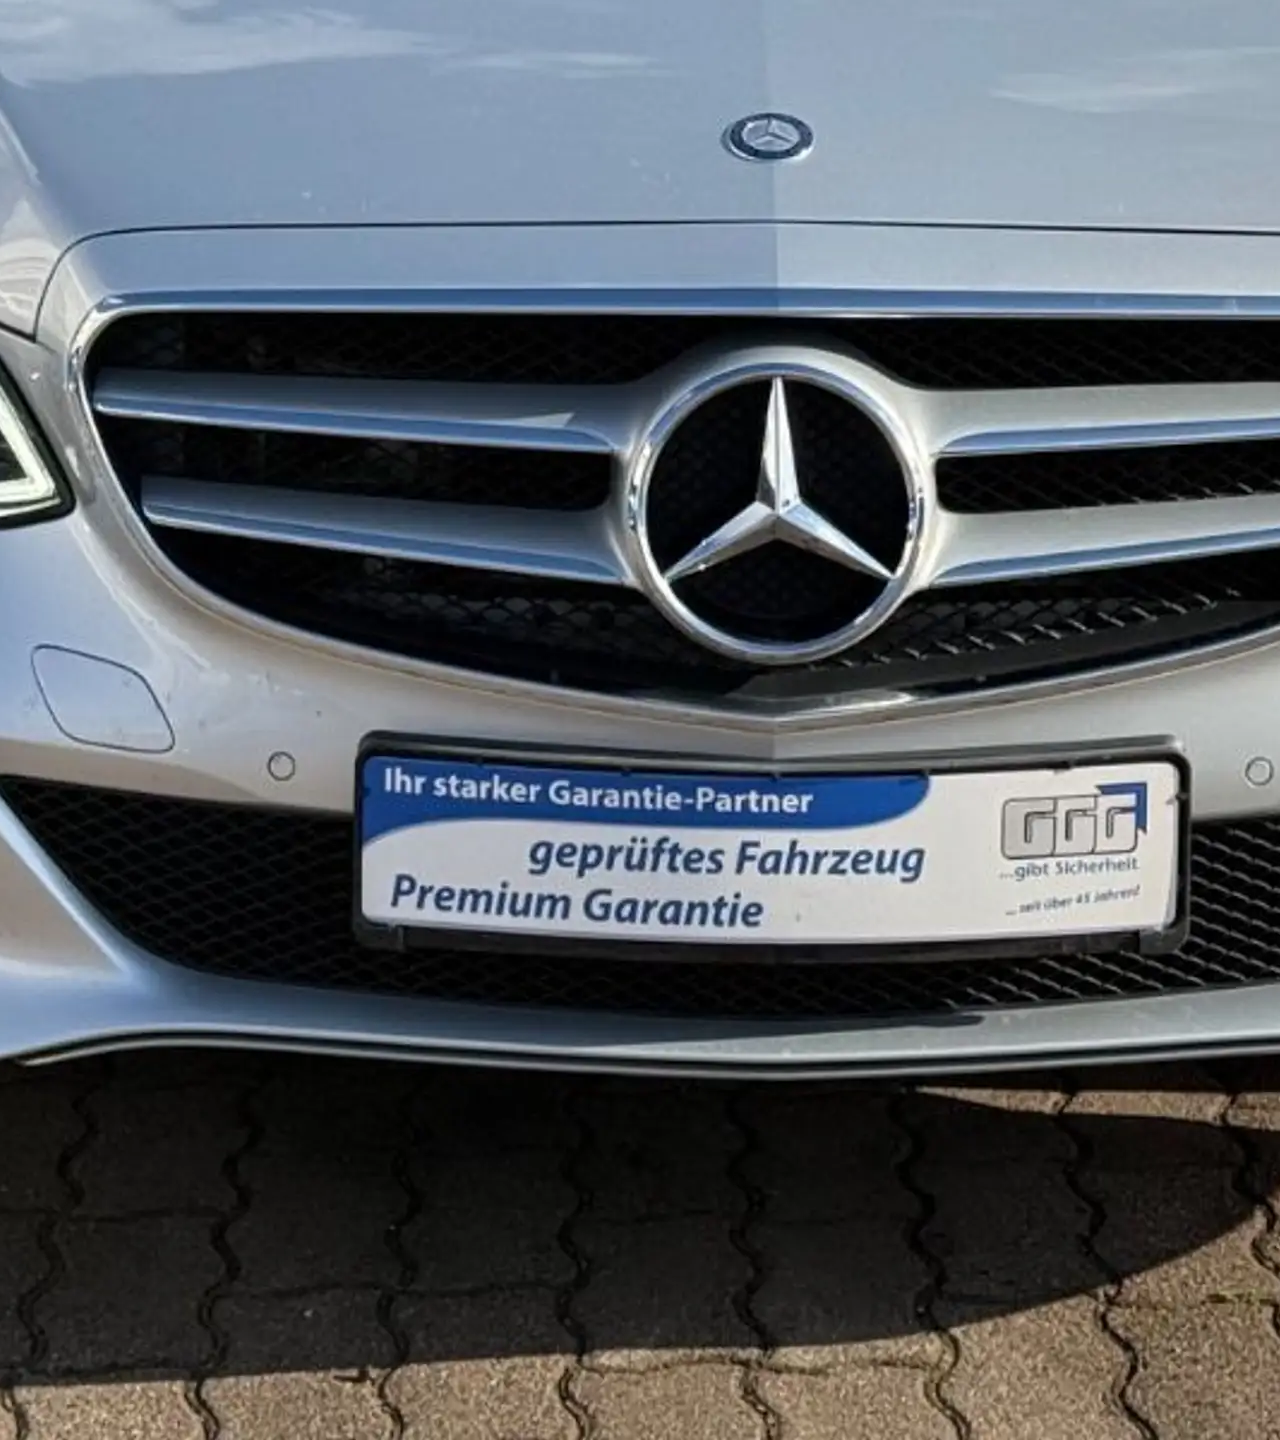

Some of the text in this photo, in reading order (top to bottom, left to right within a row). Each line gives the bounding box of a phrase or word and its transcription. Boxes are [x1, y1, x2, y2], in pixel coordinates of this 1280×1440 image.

[384, 767, 813, 813] Ihr starker Garantie-Partner
[529, 836, 925, 882] geprüftes Fahrzeug
[1055, 858, 1139, 877] Sicherheit
[391, 874, 763, 928] Premium Garantie
